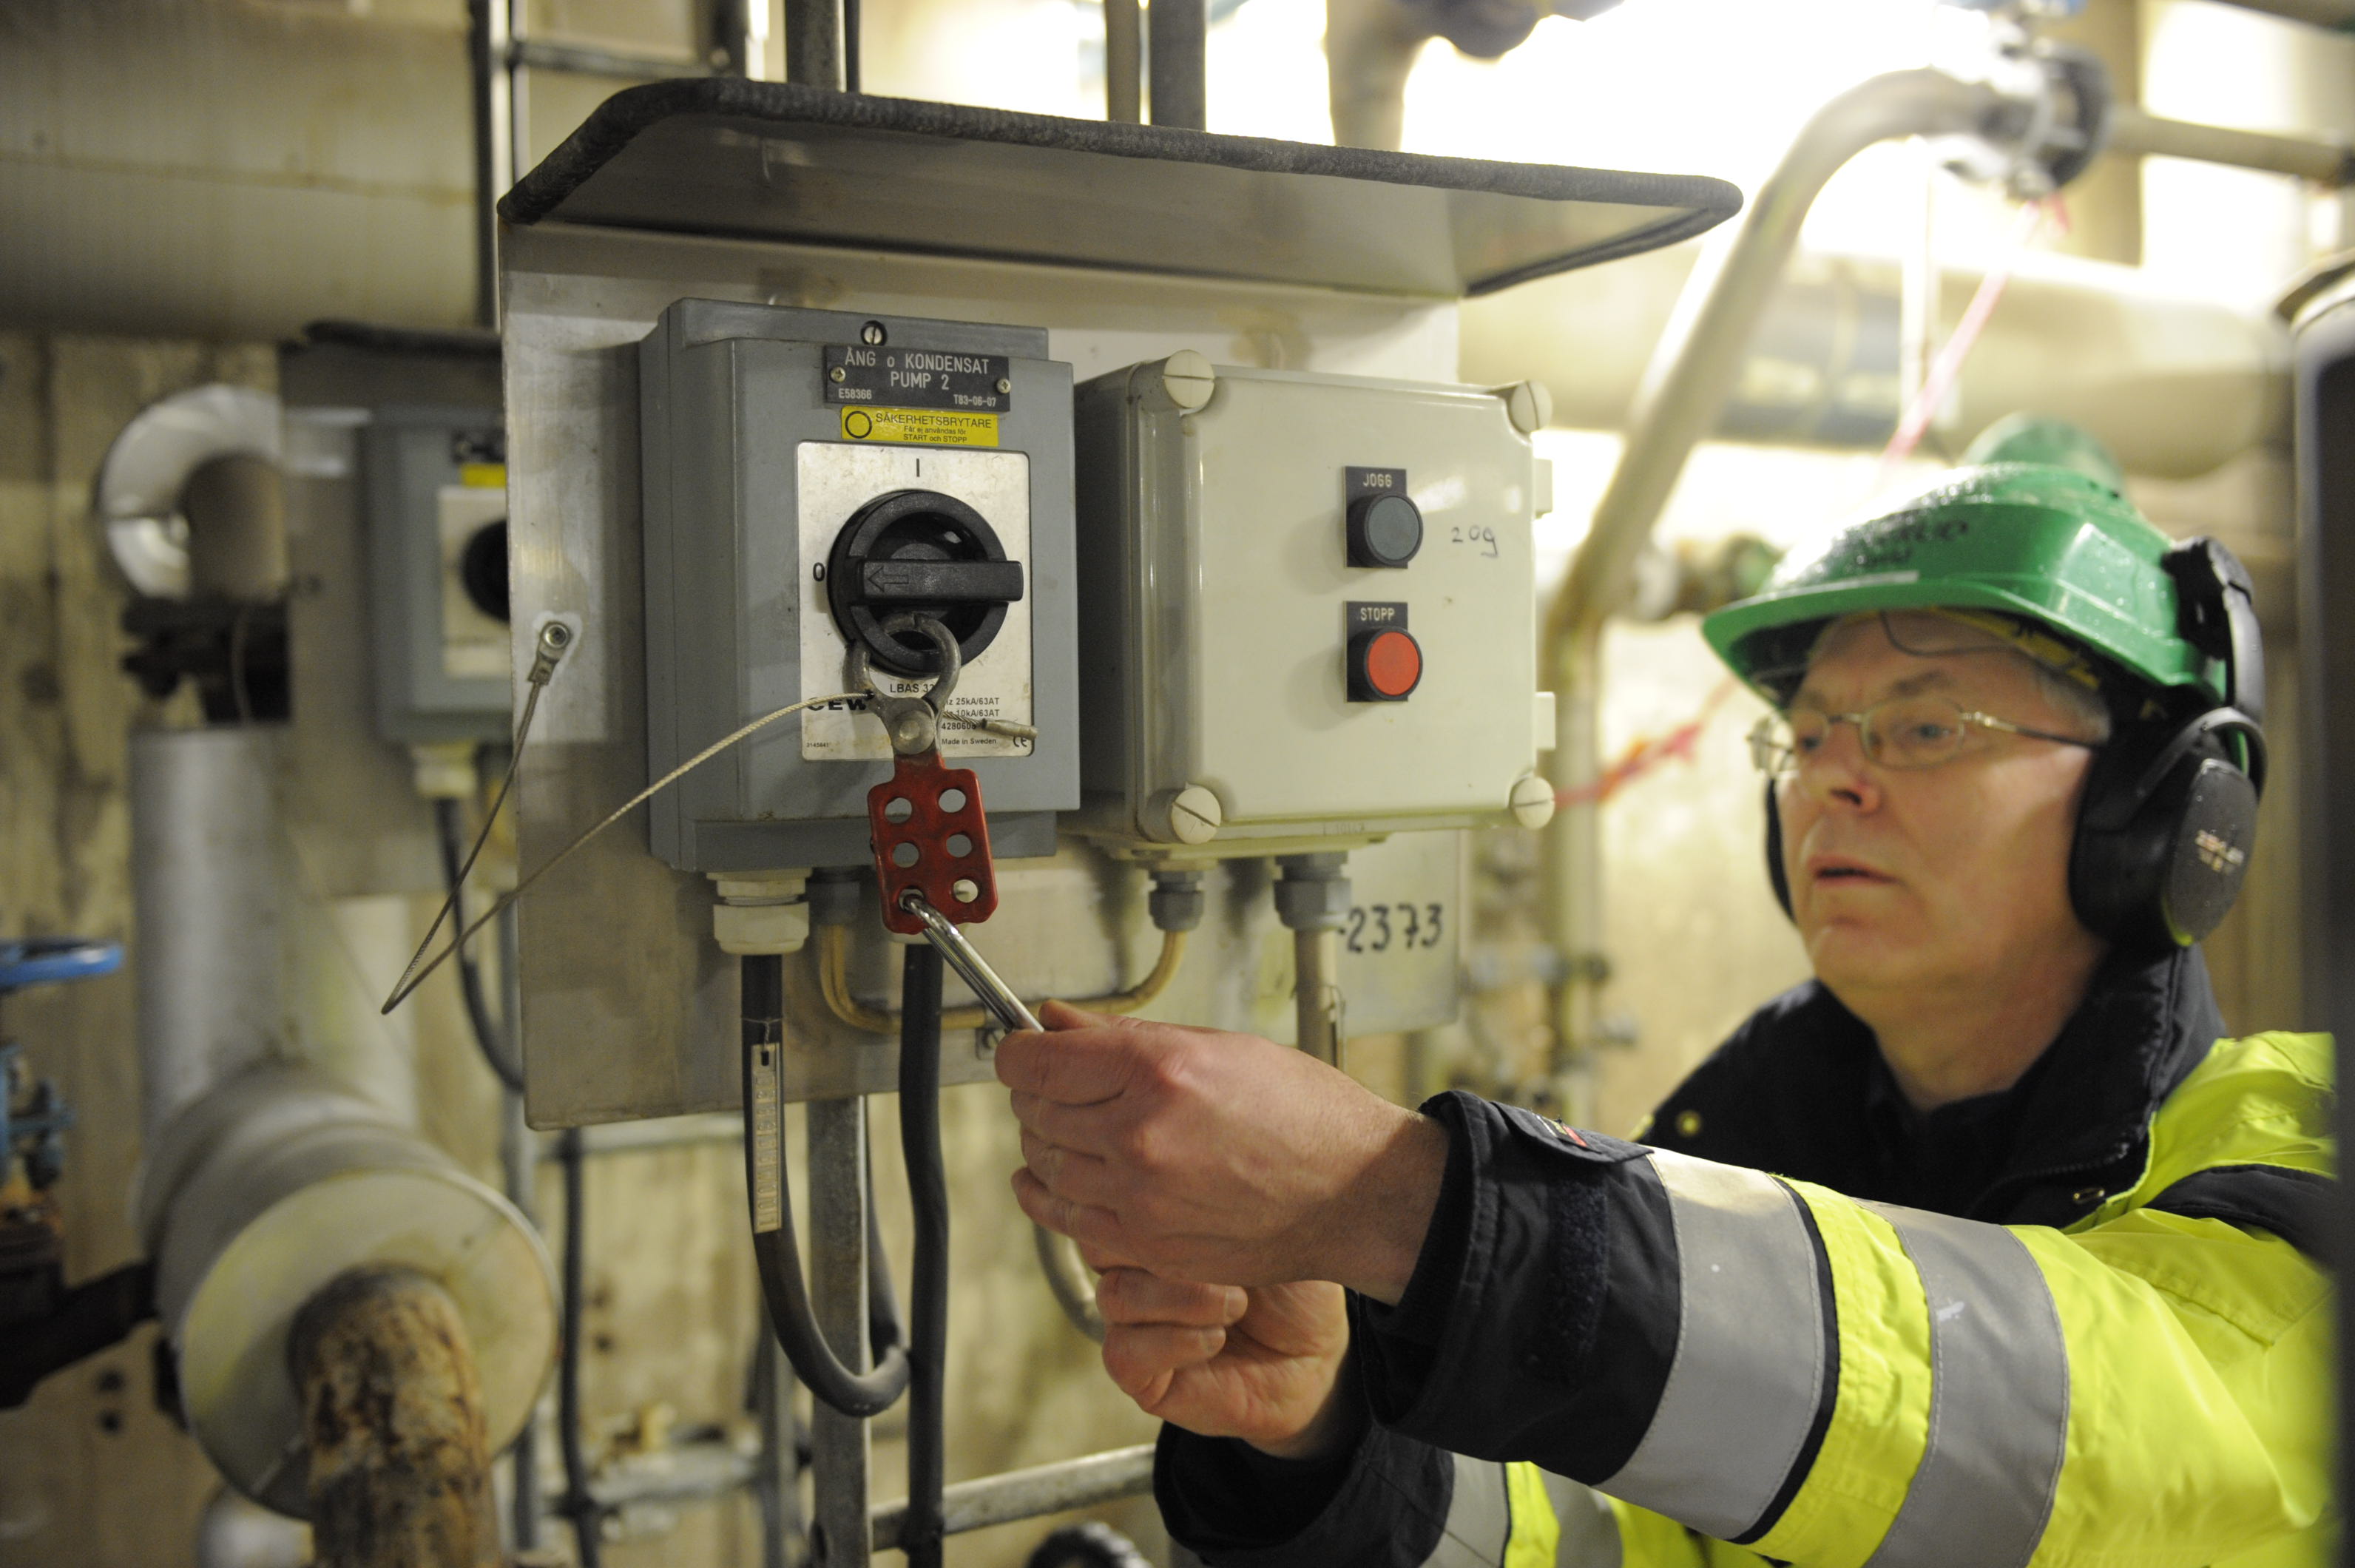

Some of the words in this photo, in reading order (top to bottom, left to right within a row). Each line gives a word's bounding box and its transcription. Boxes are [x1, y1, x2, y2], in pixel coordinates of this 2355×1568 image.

[845, 347, 876, 367] ÅNG
[905, 354, 989, 375] KONDENSAT
[891, 371, 931, 389] PUMP
[941, 374, 950, 391] 2
[876, 412, 992, 428] SÄKERHETSBRYTARE
[1360, 607, 1395, 622] STOPP
[890, 683, 919, 693] LBAS
